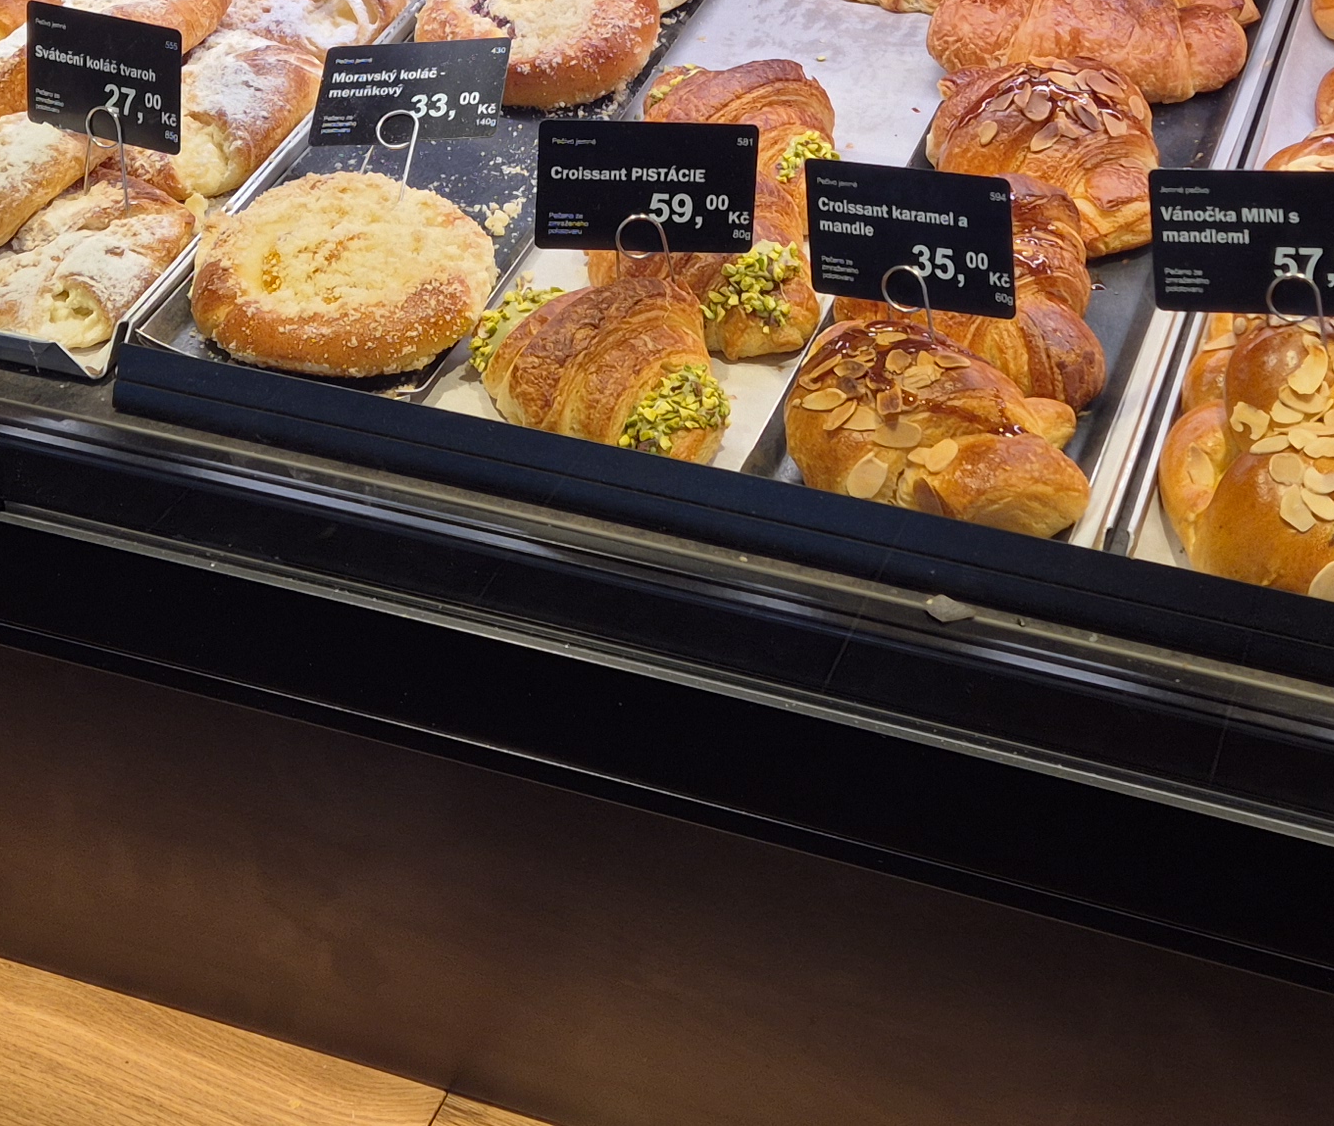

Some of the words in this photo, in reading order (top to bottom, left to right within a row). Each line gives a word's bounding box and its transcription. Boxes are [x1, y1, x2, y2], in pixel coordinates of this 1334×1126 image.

[35, 45, 84, 66] Sváteční
[86, 56, 118, 74] koláč
[119, 63, 156, 83] tvaroh
[332, 70, 397, 84] Moravský
[400, 67, 437, 80] koláč
[329, 84, 403, 98] meruňkový
[103, 83, 162, 124] 27,00
[161, 112, 177, 127] Kč
[410, 92, 480, 120] 33,00
[477, 104, 497, 115] Kč
[550, 166, 627, 181] Croissant
[631, 165, 706, 183] PISTÁCIE
[989, 192, 1007, 202] 594
[649, 193, 729, 229] 59,00
[728, 212, 750, 224] Kč
[818, 197, 889, 218] Croissant
[891, 205, 954, 226] karamel
[958, 215, 968, 228] a
[1160, 206, 1237, 223] Vánočka
[1241, 208, 1284, 223] MINI
[1288, 211, 1300, 223] s
[819, 220, 874, 237] mandle
[1162, 229, 1250, 244] mandlemi
[911, 245, 988, 287] 35,00
[989, 272, 1011, 287] Kč
